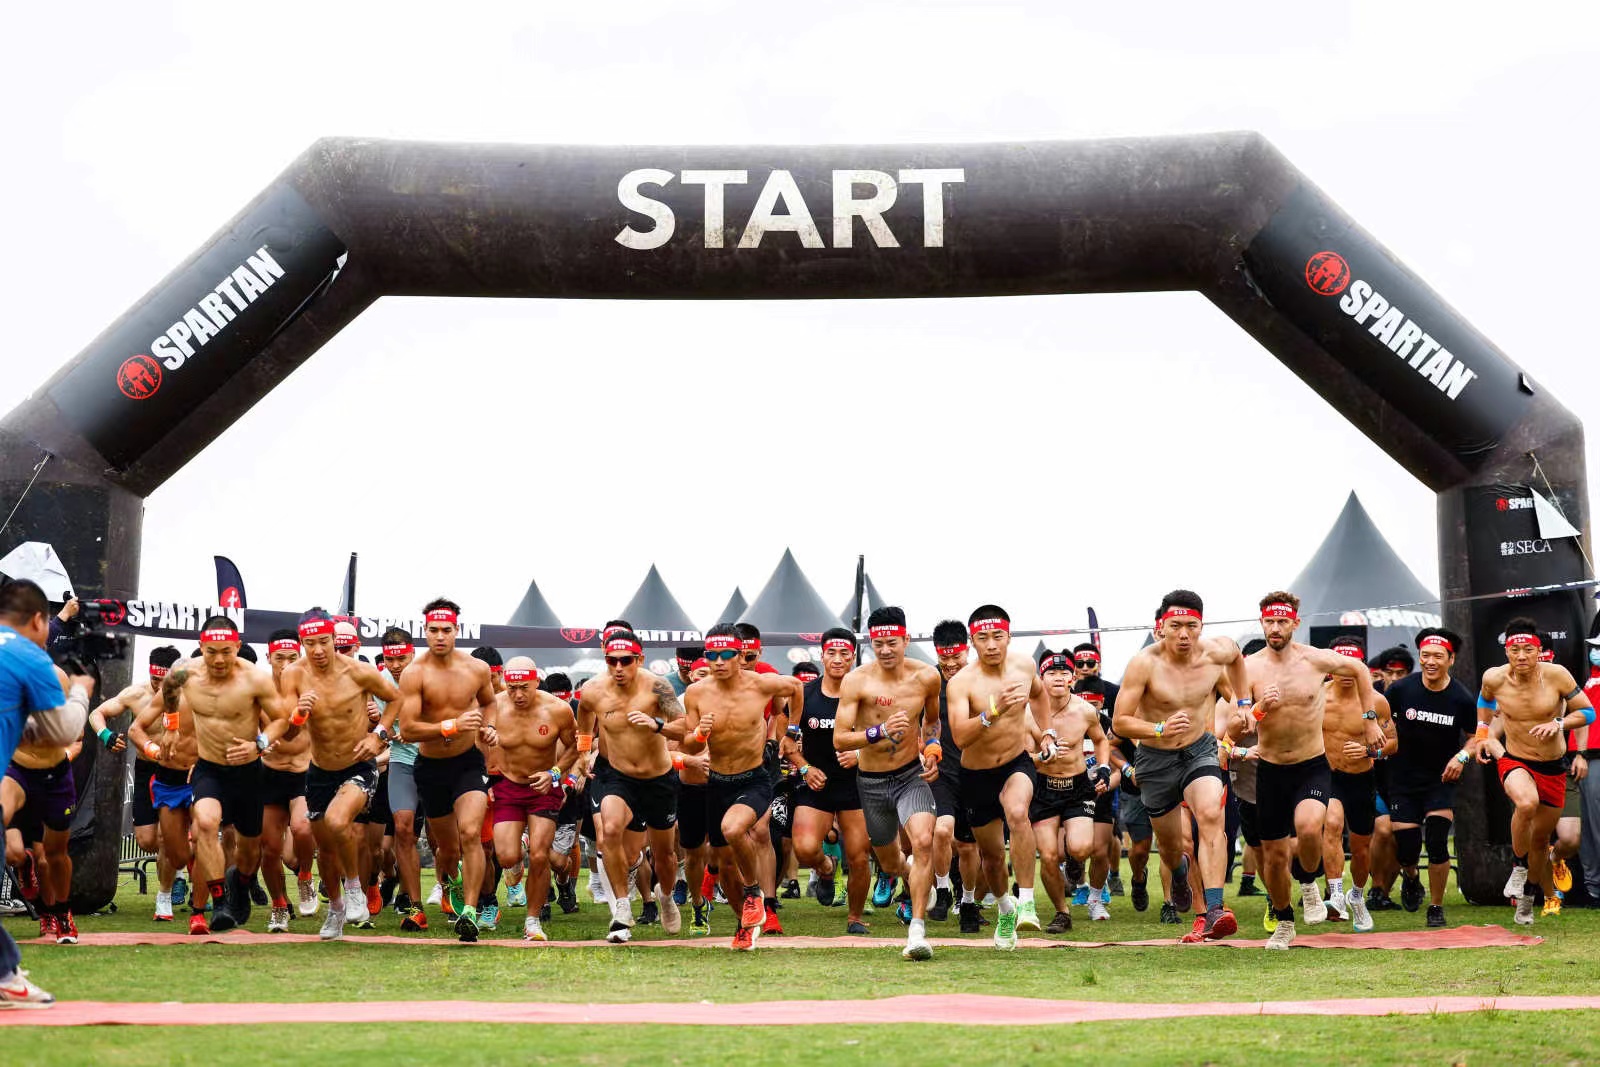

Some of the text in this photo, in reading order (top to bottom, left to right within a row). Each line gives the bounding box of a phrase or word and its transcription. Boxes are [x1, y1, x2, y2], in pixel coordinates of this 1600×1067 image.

[614, 168, 965, 250] START
[151, 247, 286, 371] SPARTAN
[1339, 279, 1475, 401] SPARTAN
[1508, 497, 1533, 510] SPAR
[1516, 539, 1553, 554] SECA
[1417, 710, 1455, 726] SPARTAN
